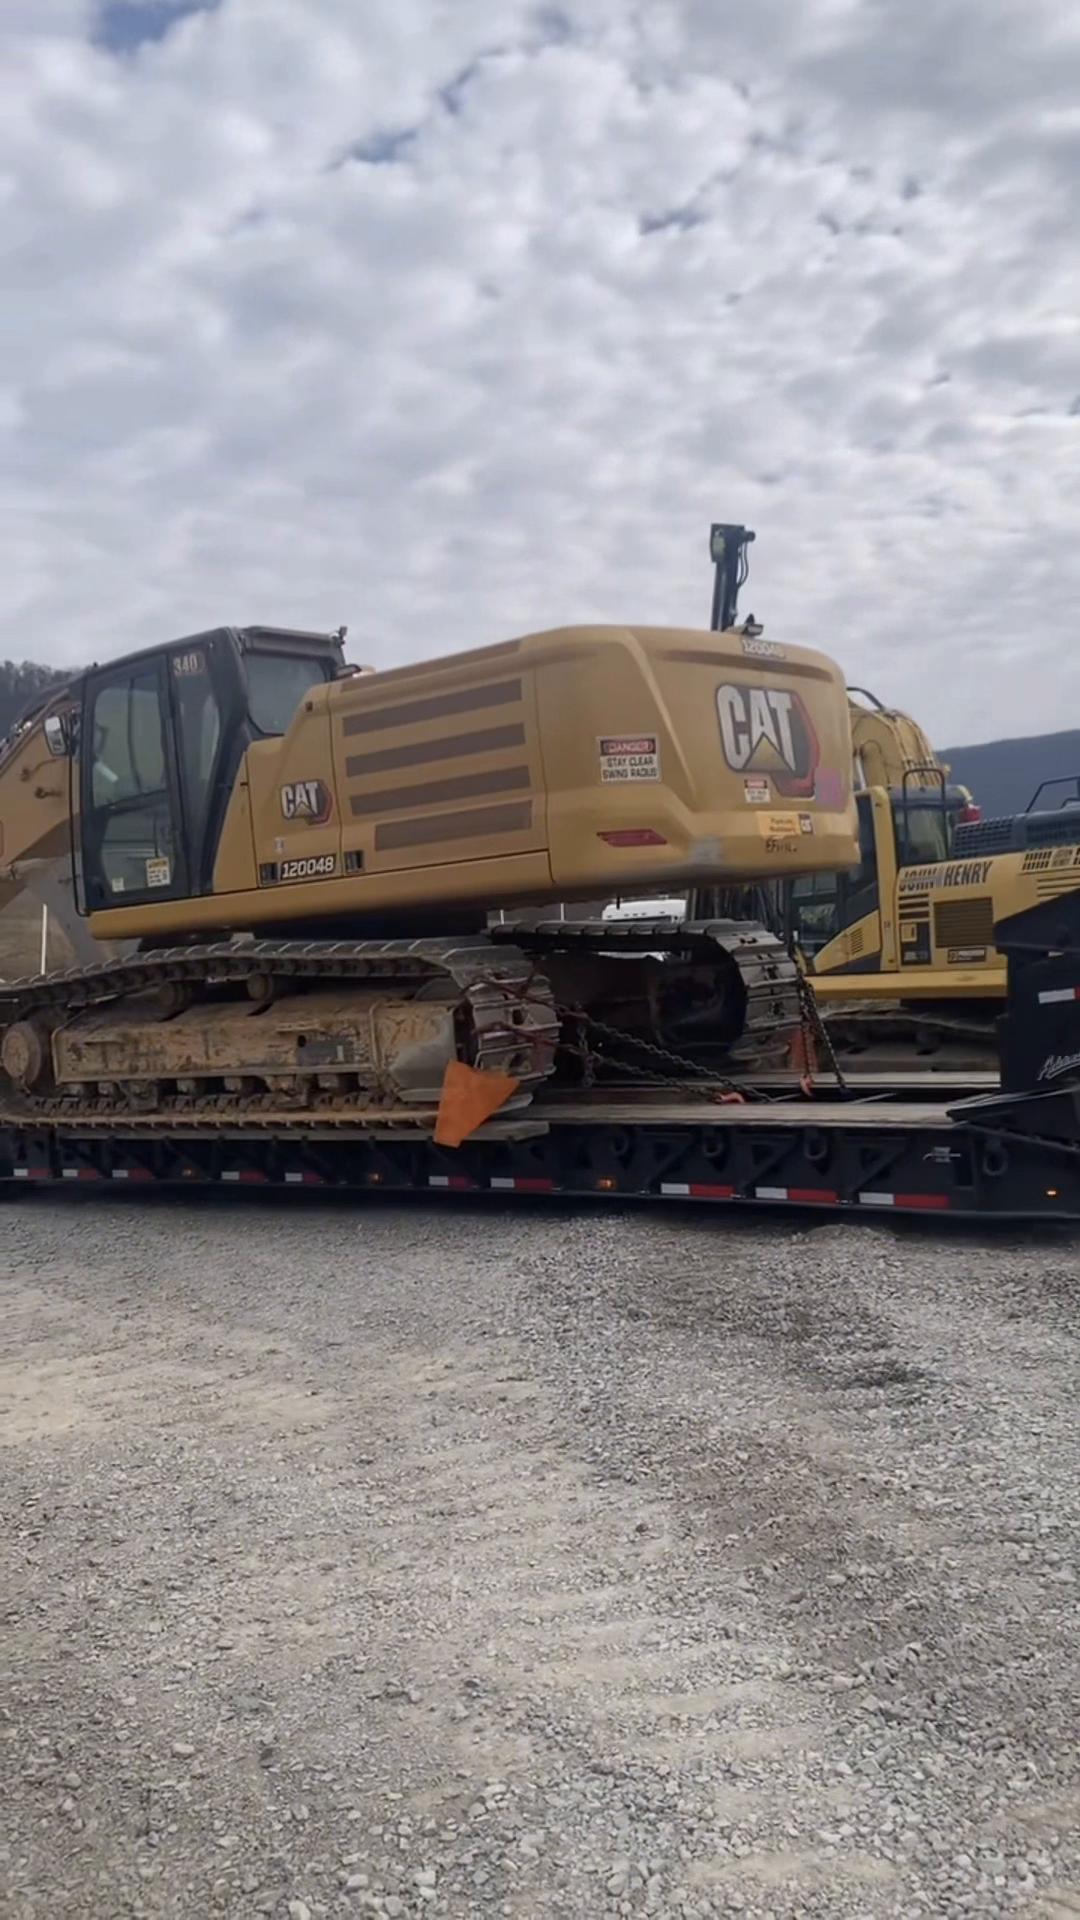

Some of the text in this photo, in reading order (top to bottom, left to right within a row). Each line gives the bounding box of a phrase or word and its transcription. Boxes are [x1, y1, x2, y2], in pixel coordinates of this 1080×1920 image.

[173, 653, 198, 673] 340
[717, 684, 797, 771] CAT
[606, 741, 651, 753] DANGER
[607, 755, 653, 768] STAY CLEAR
[602, 767, 657, 779] SWING RADIUS
[281, 782, 318, 818] CAT
[282, 856, 334, 878] 120048
[943, 861, 993, 887] HENRY
